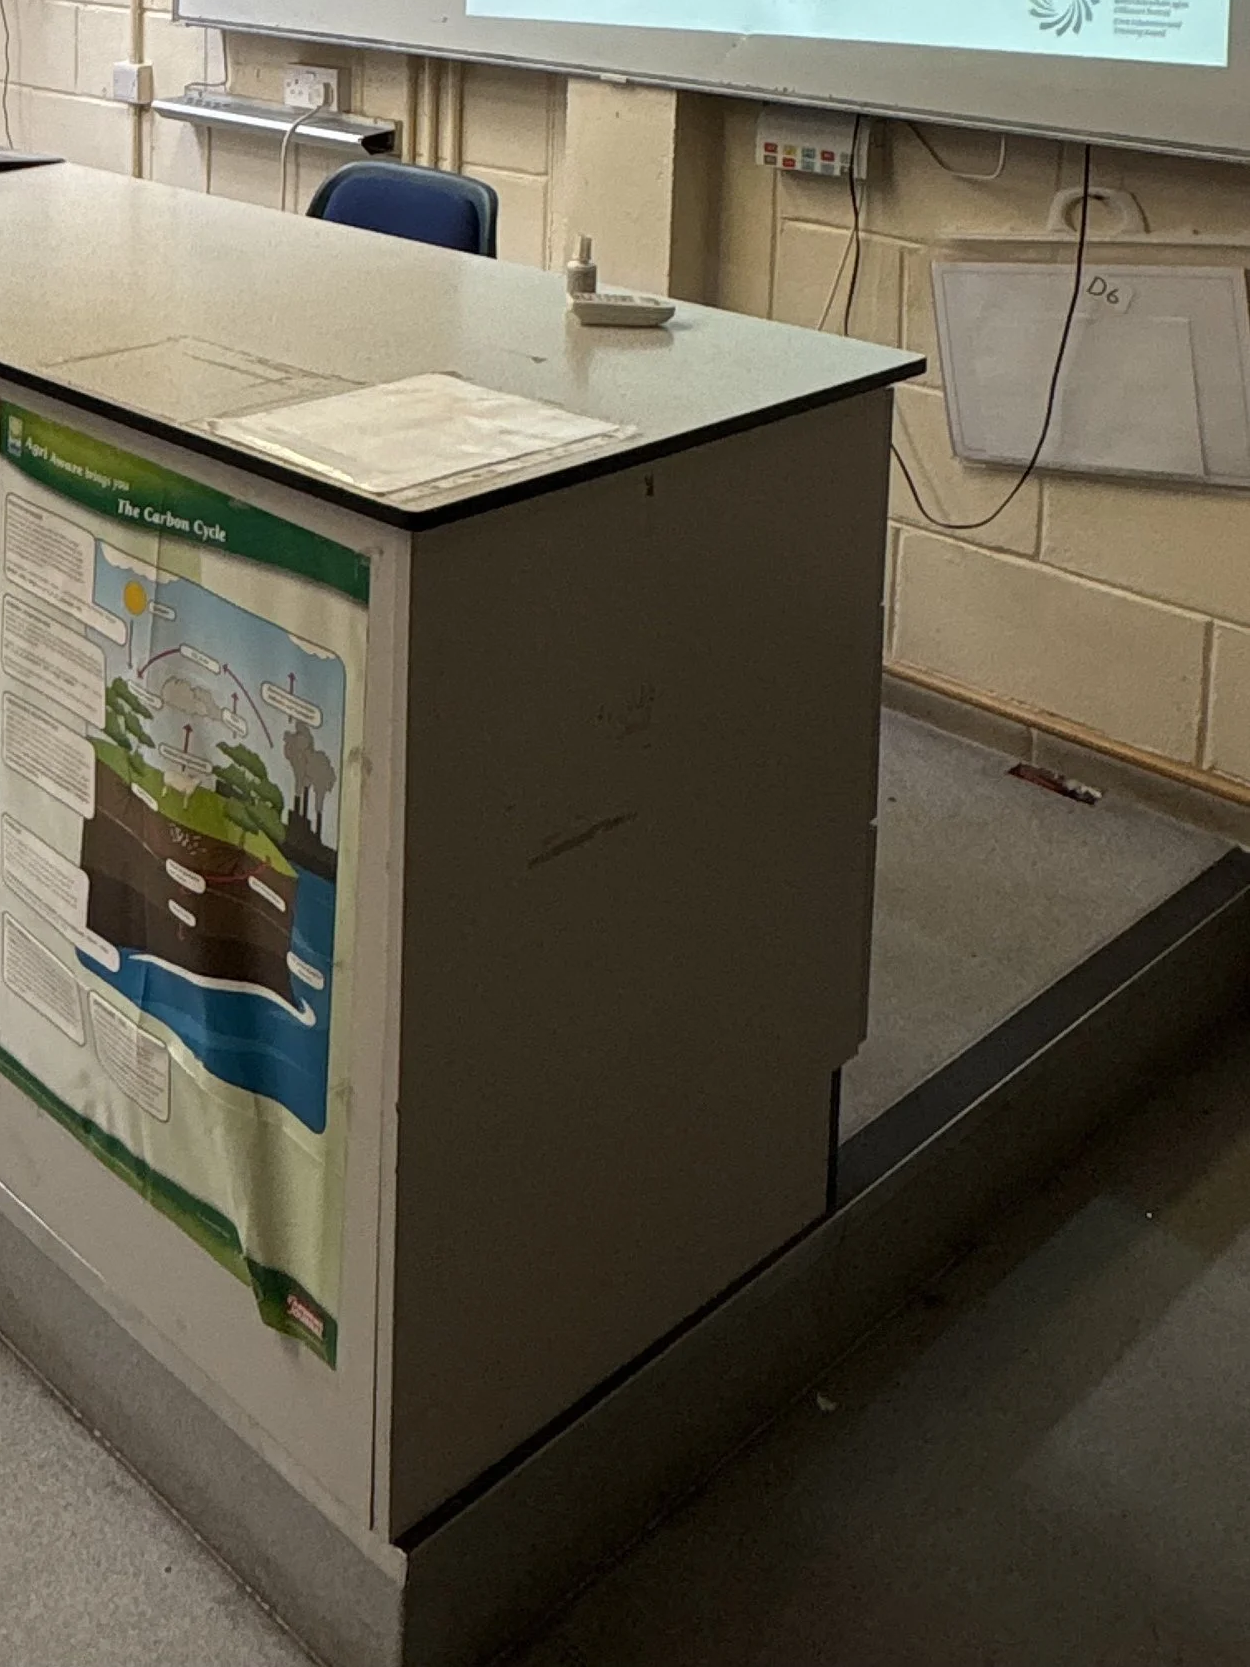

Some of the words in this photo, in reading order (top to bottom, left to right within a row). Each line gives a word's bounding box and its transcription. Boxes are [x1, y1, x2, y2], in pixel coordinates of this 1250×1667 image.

[1086, 276, 1120, 305] D6
[25, 437, 48, 459] Agri
[50, 454, 84, 476] Aware
[112, 479, 130, 491] you
[117, 498, 140, 519] The
[144, 507, 190, 532] Carbon
[193, 520, 227, 543] Cycle
